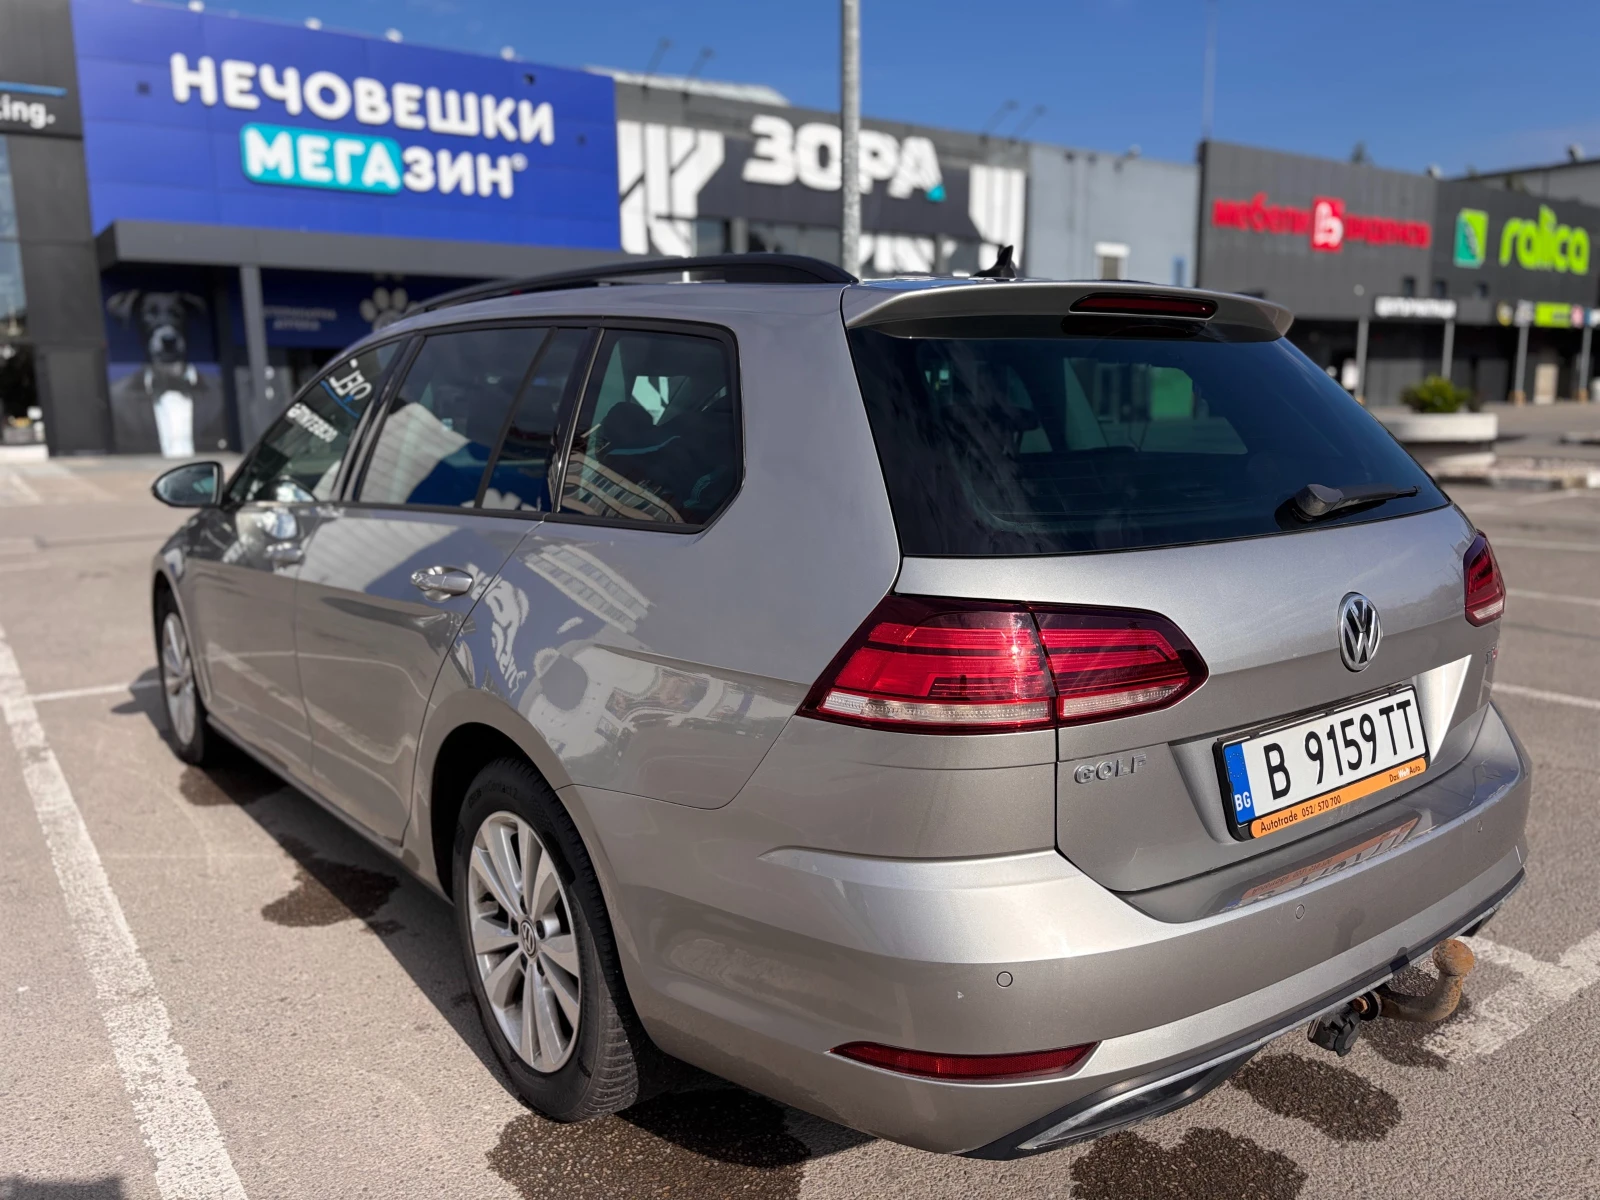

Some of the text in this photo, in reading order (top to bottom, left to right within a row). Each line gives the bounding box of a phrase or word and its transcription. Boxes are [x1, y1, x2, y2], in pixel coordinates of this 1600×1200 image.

[0, 94, 56, 130] ing.
[169, 52, 555, 147] НЕЧОВЕШКИ
[741, 114, 943, 201] ЗОРА
[1498, 204, 1590, 276] ralica
[1073, 753, 1147, 785] GOLF
[1263, 742, 1291, 801] B
[1234, 791, 1252, 812] BG
[1260, 810, 1298, 833] Autotrade
[1317, 799, 1330, 812] 570
[1329, 794, 1342, 806] 700
